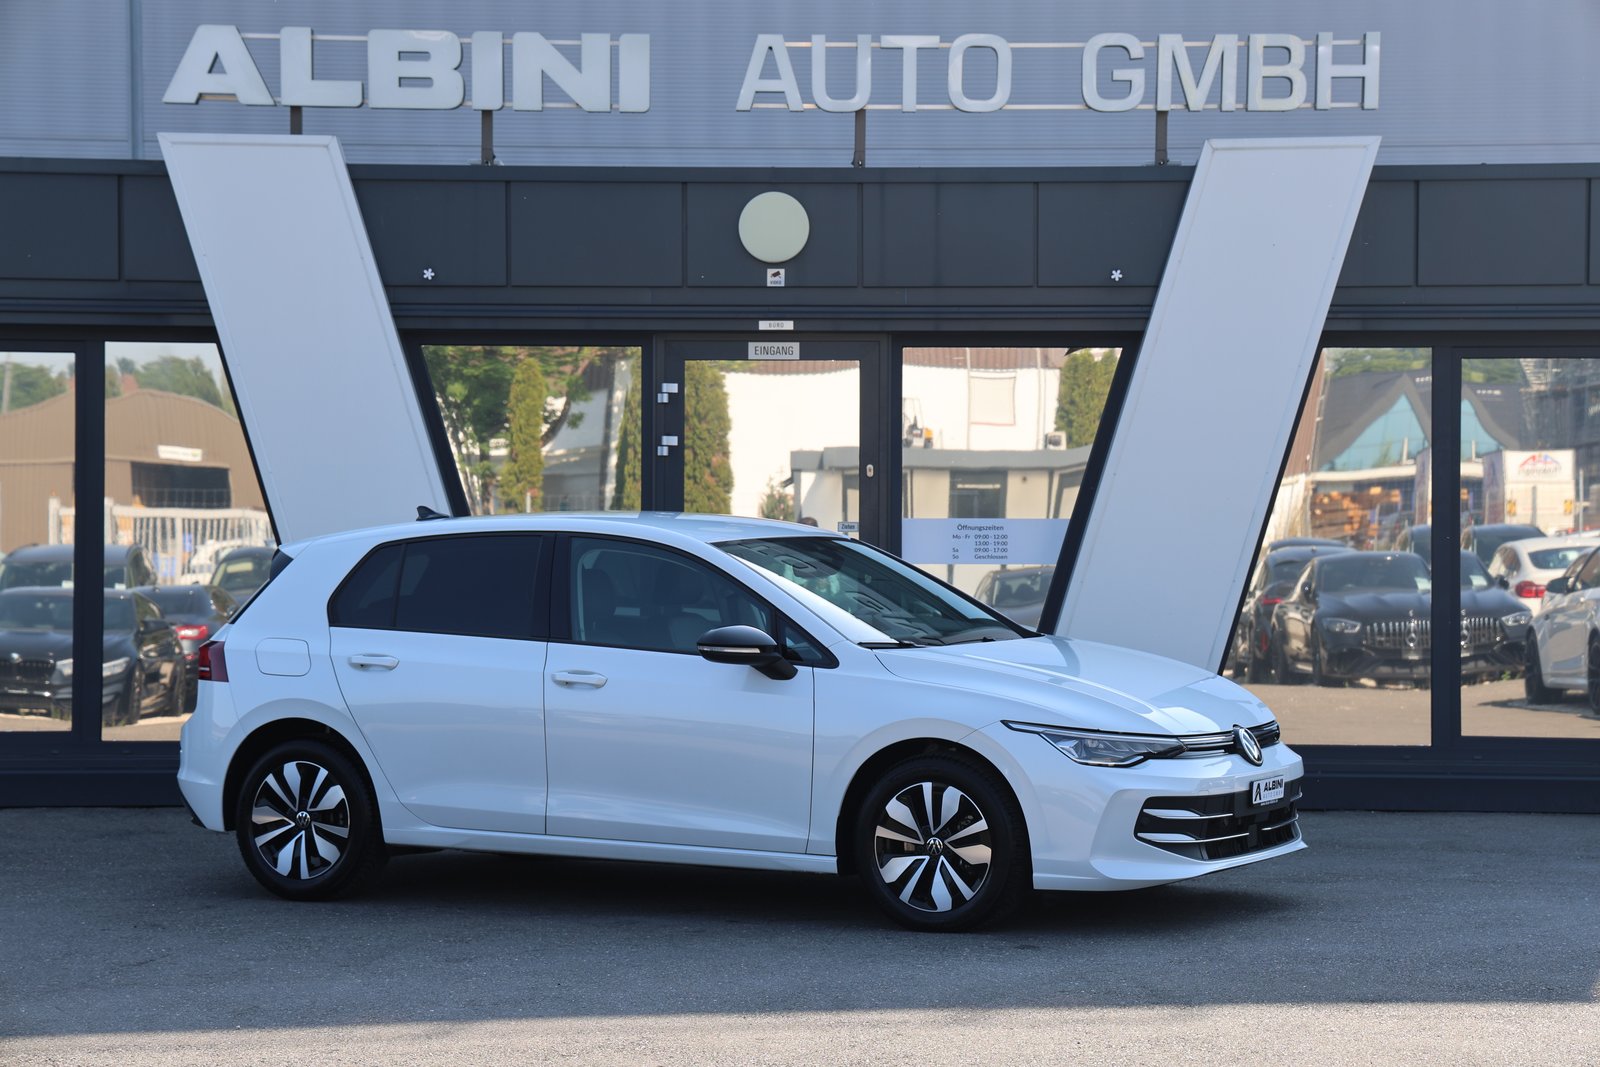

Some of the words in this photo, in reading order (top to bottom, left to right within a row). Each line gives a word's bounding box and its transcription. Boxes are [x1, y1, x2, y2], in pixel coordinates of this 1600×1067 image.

[162, 24, 650, 113] ALBINI
[736, 33, 1013, 113] AUTO
[1081, 31, 1381, 112] GMBH
[754, 345, 794, 356] EINGANG
[957, 523, 1004, 532] Öffnungszeiten
